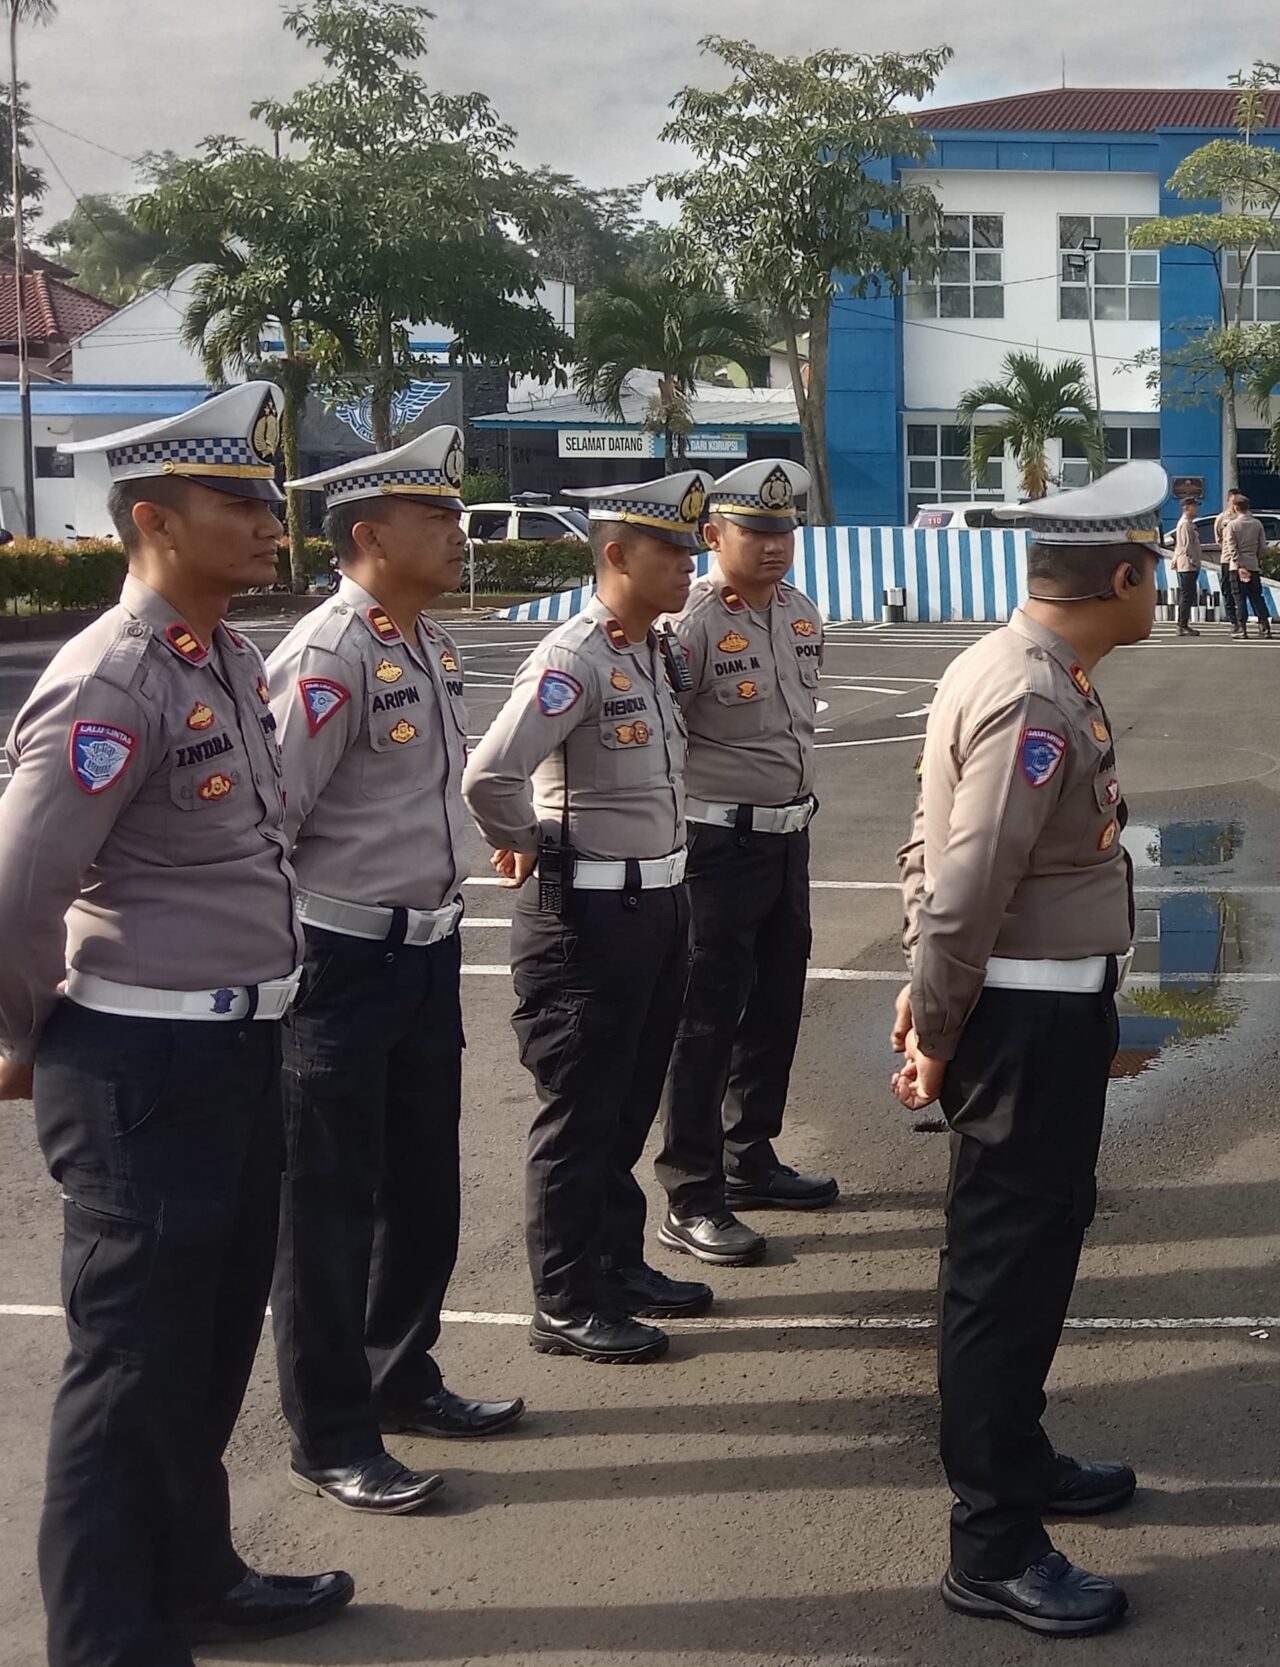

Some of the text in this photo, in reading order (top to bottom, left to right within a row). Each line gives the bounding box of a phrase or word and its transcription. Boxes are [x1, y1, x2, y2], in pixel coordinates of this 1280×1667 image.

[565, 436, 643, 452] SELAMAT DATANG
[690, 440, 707, 451] DARI
[708, 440, 738, 452] KORUPSI
[928, 516, 942, 525] 110
[372, 685, 421, 714] ARIPIN
[80, 724, 132, 744] LALU LINTAS
[175, 732, 234, 768] INDRA
